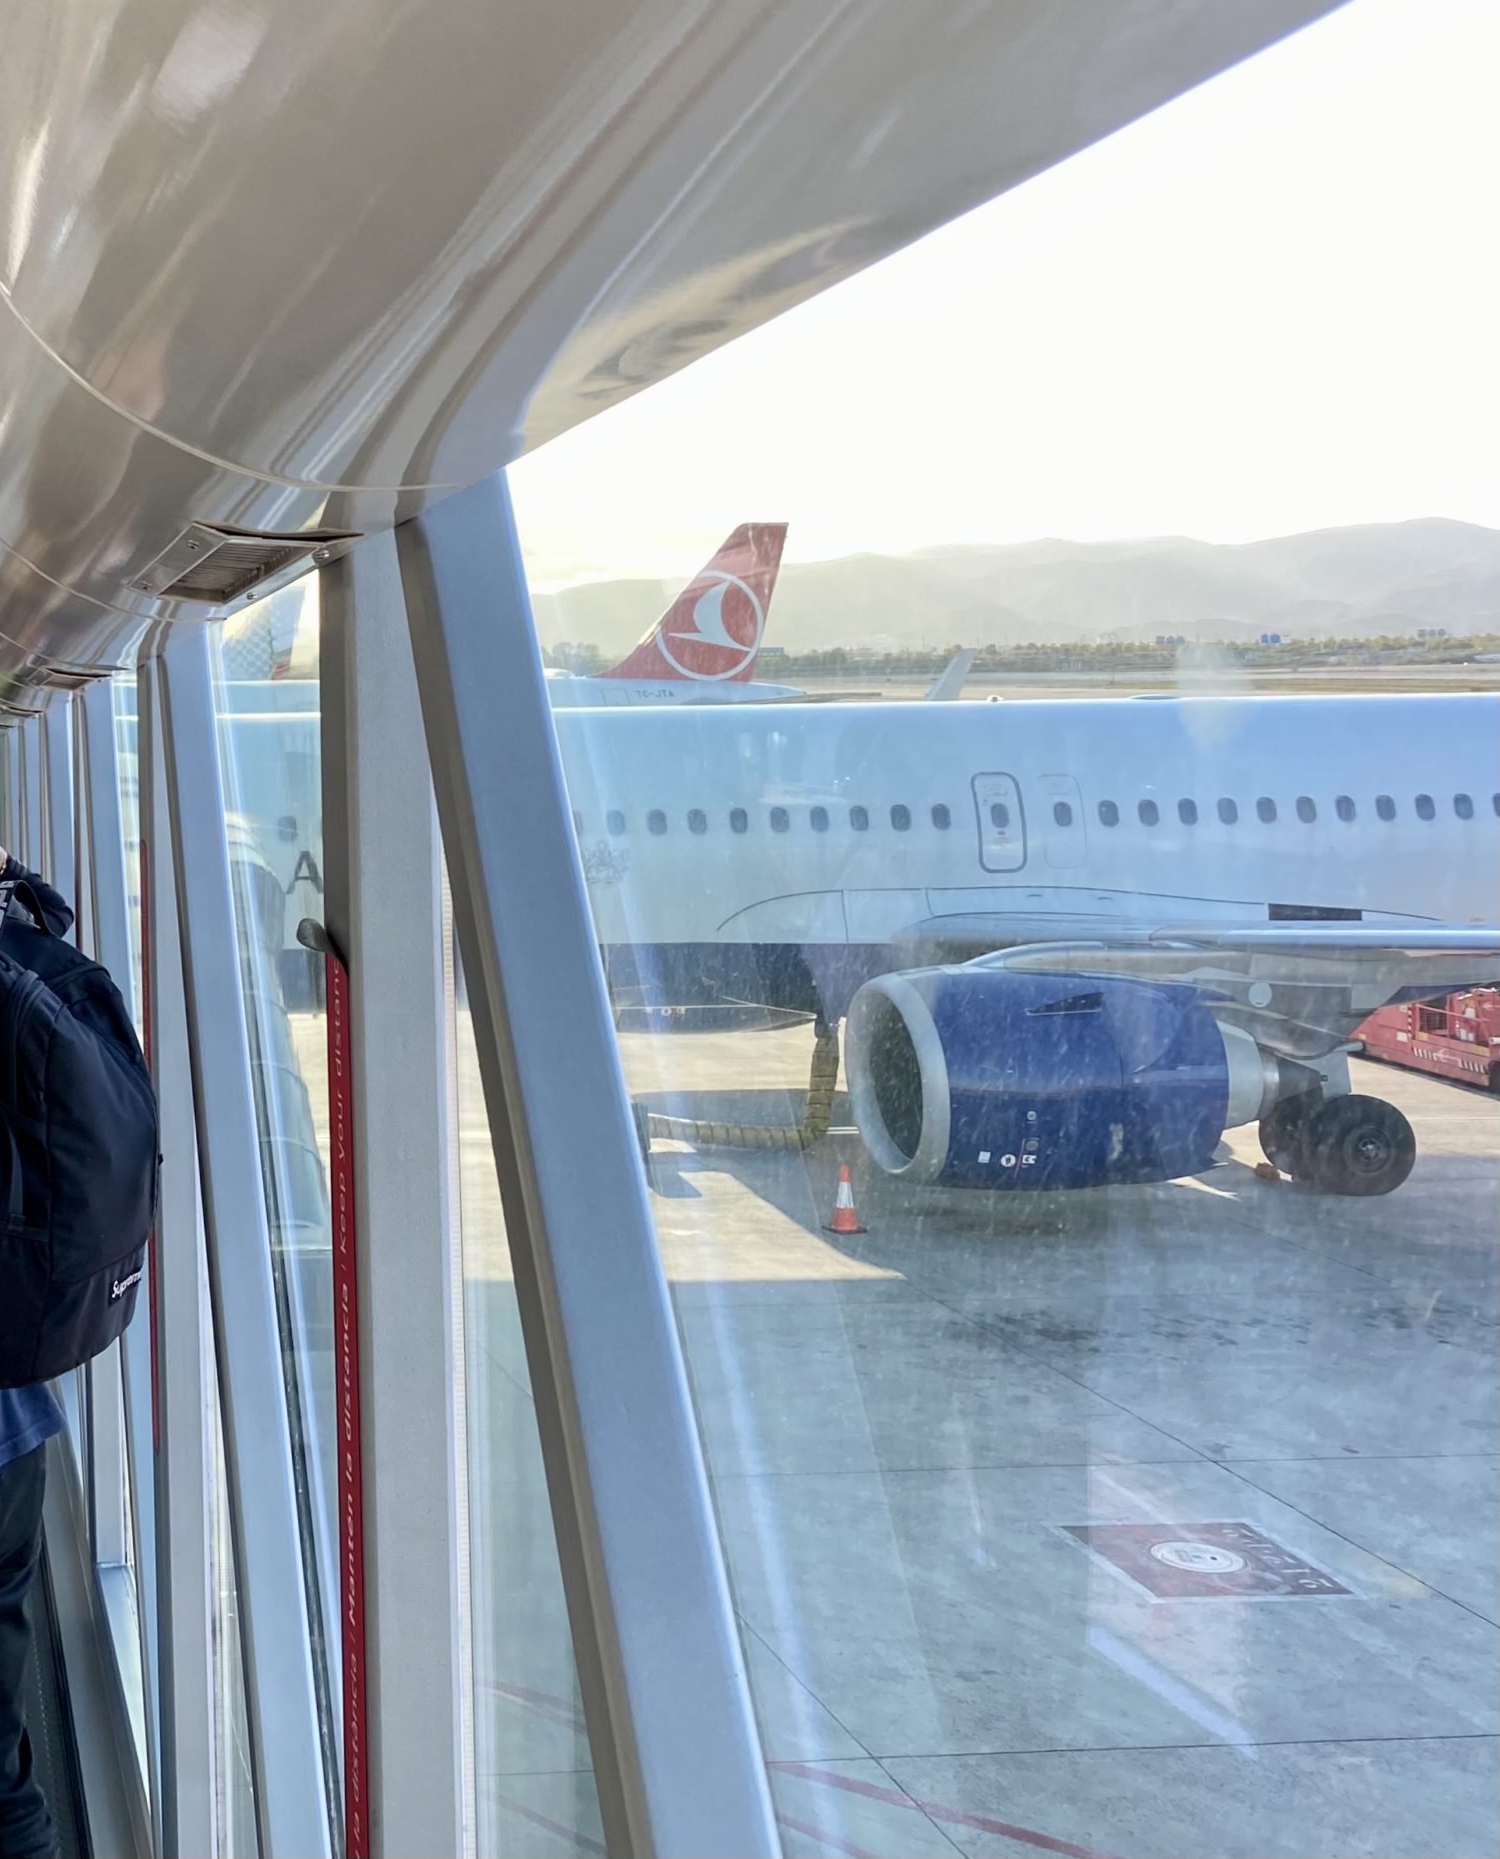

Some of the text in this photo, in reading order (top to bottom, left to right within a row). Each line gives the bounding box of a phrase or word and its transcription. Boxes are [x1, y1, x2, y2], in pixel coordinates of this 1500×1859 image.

[333, 959, 342, 1077] distanc
[337, 1087, 346, 1163] your
[339, 1172, 347, 1254] Keep
